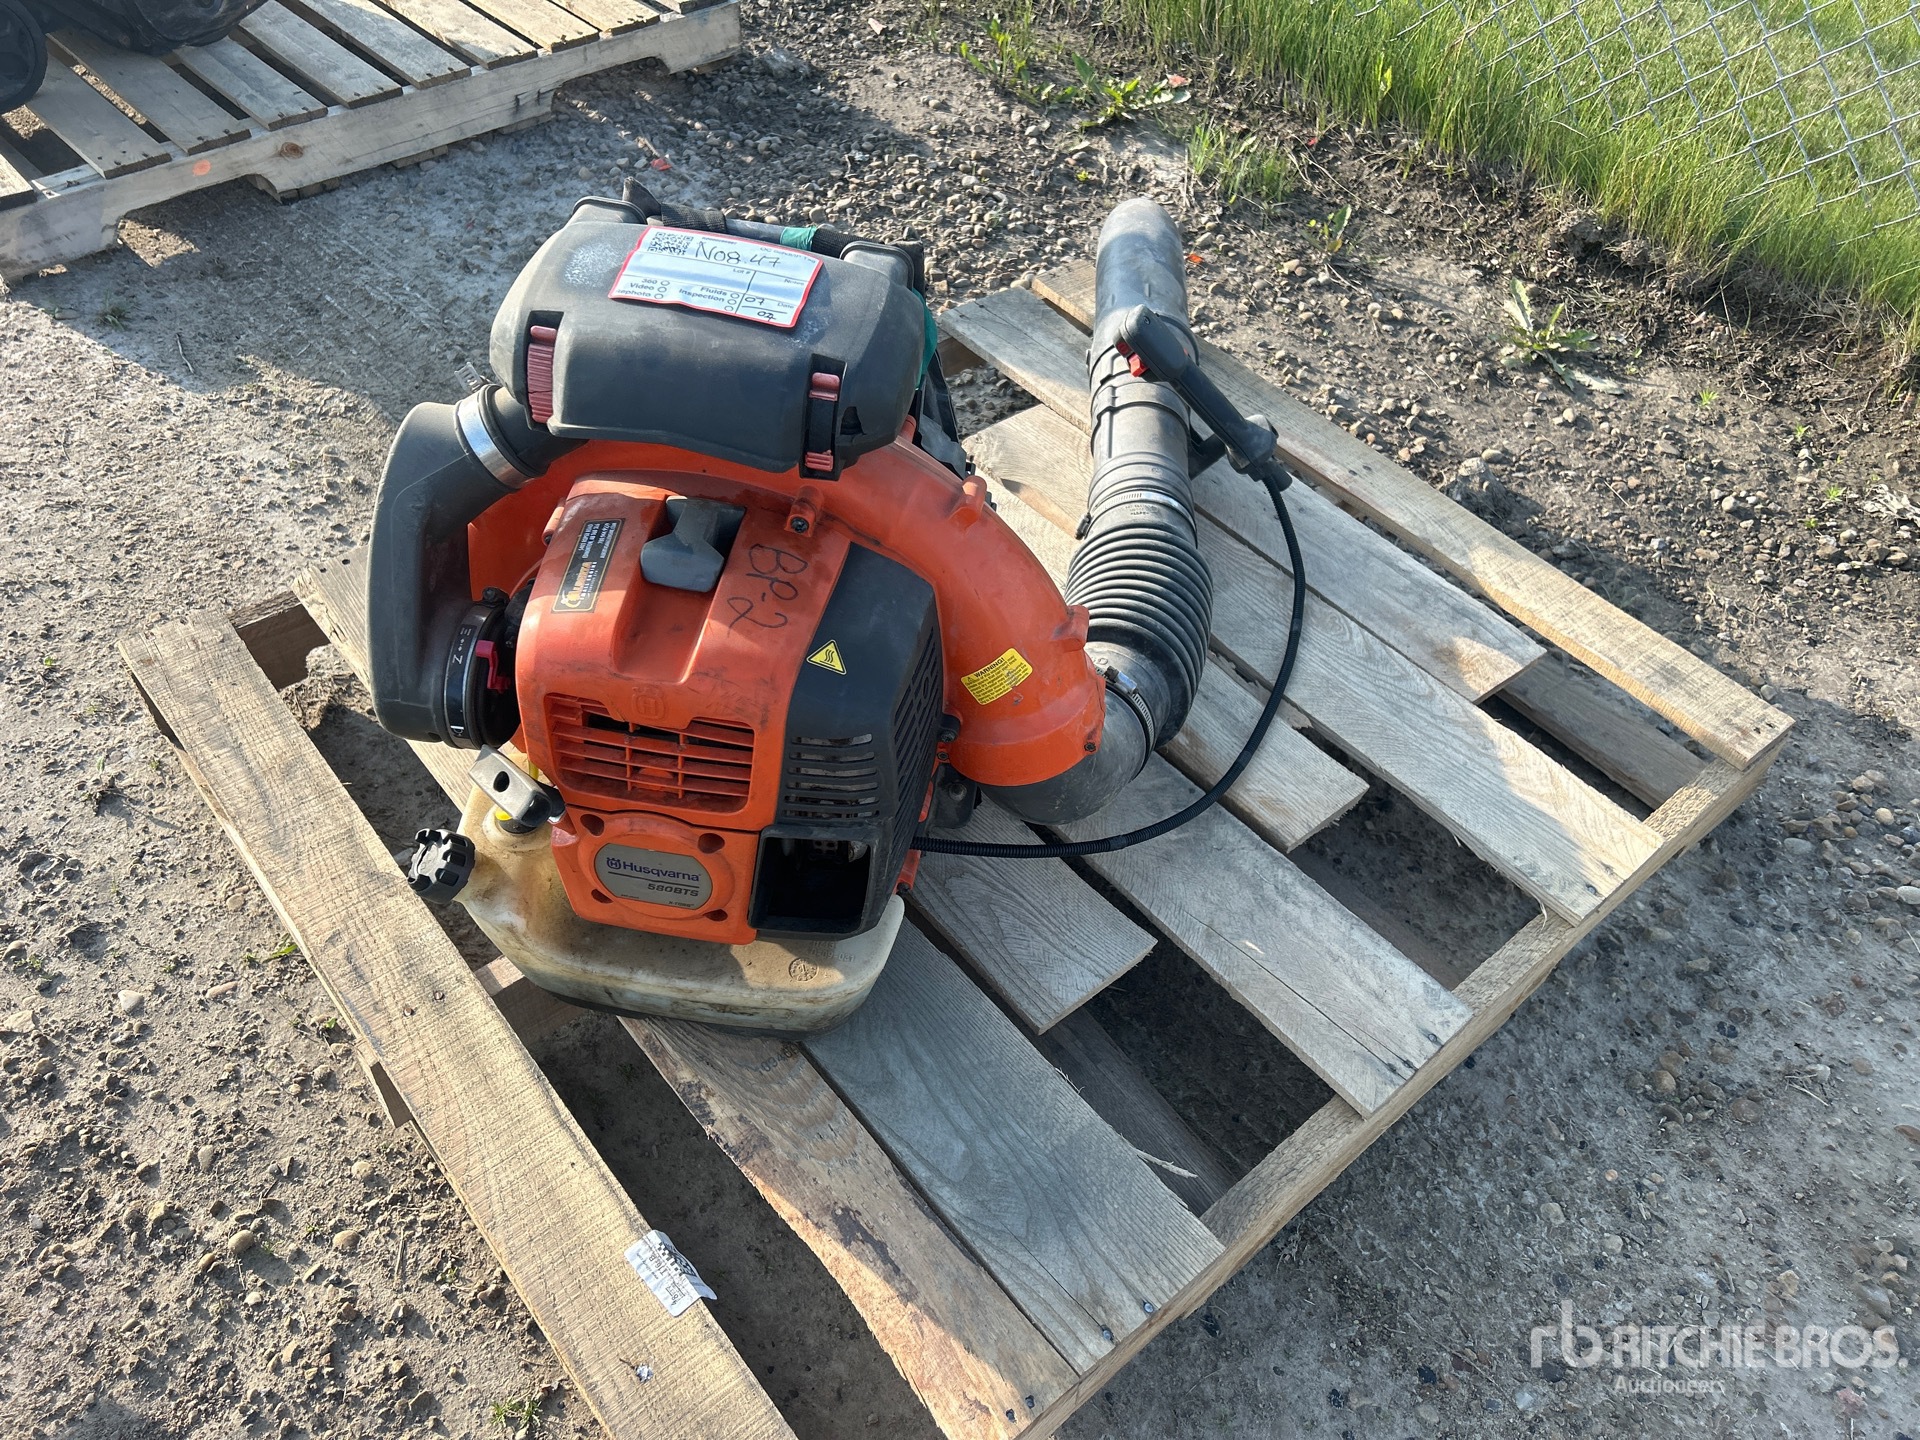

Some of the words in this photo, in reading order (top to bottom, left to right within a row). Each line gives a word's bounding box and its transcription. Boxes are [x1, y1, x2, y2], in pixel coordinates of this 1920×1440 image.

[630, 282, 655, 291] Video
[700, 286, 728, 296] Fluids
[678, 288, 725, 303] Inspection
[777, 301, 795, 309] Date
[974, 656, 1006, 678] WARNING!
[623, 861, 700, 882] Husqvarna
[647, 883, 699, 897] 580BTS
